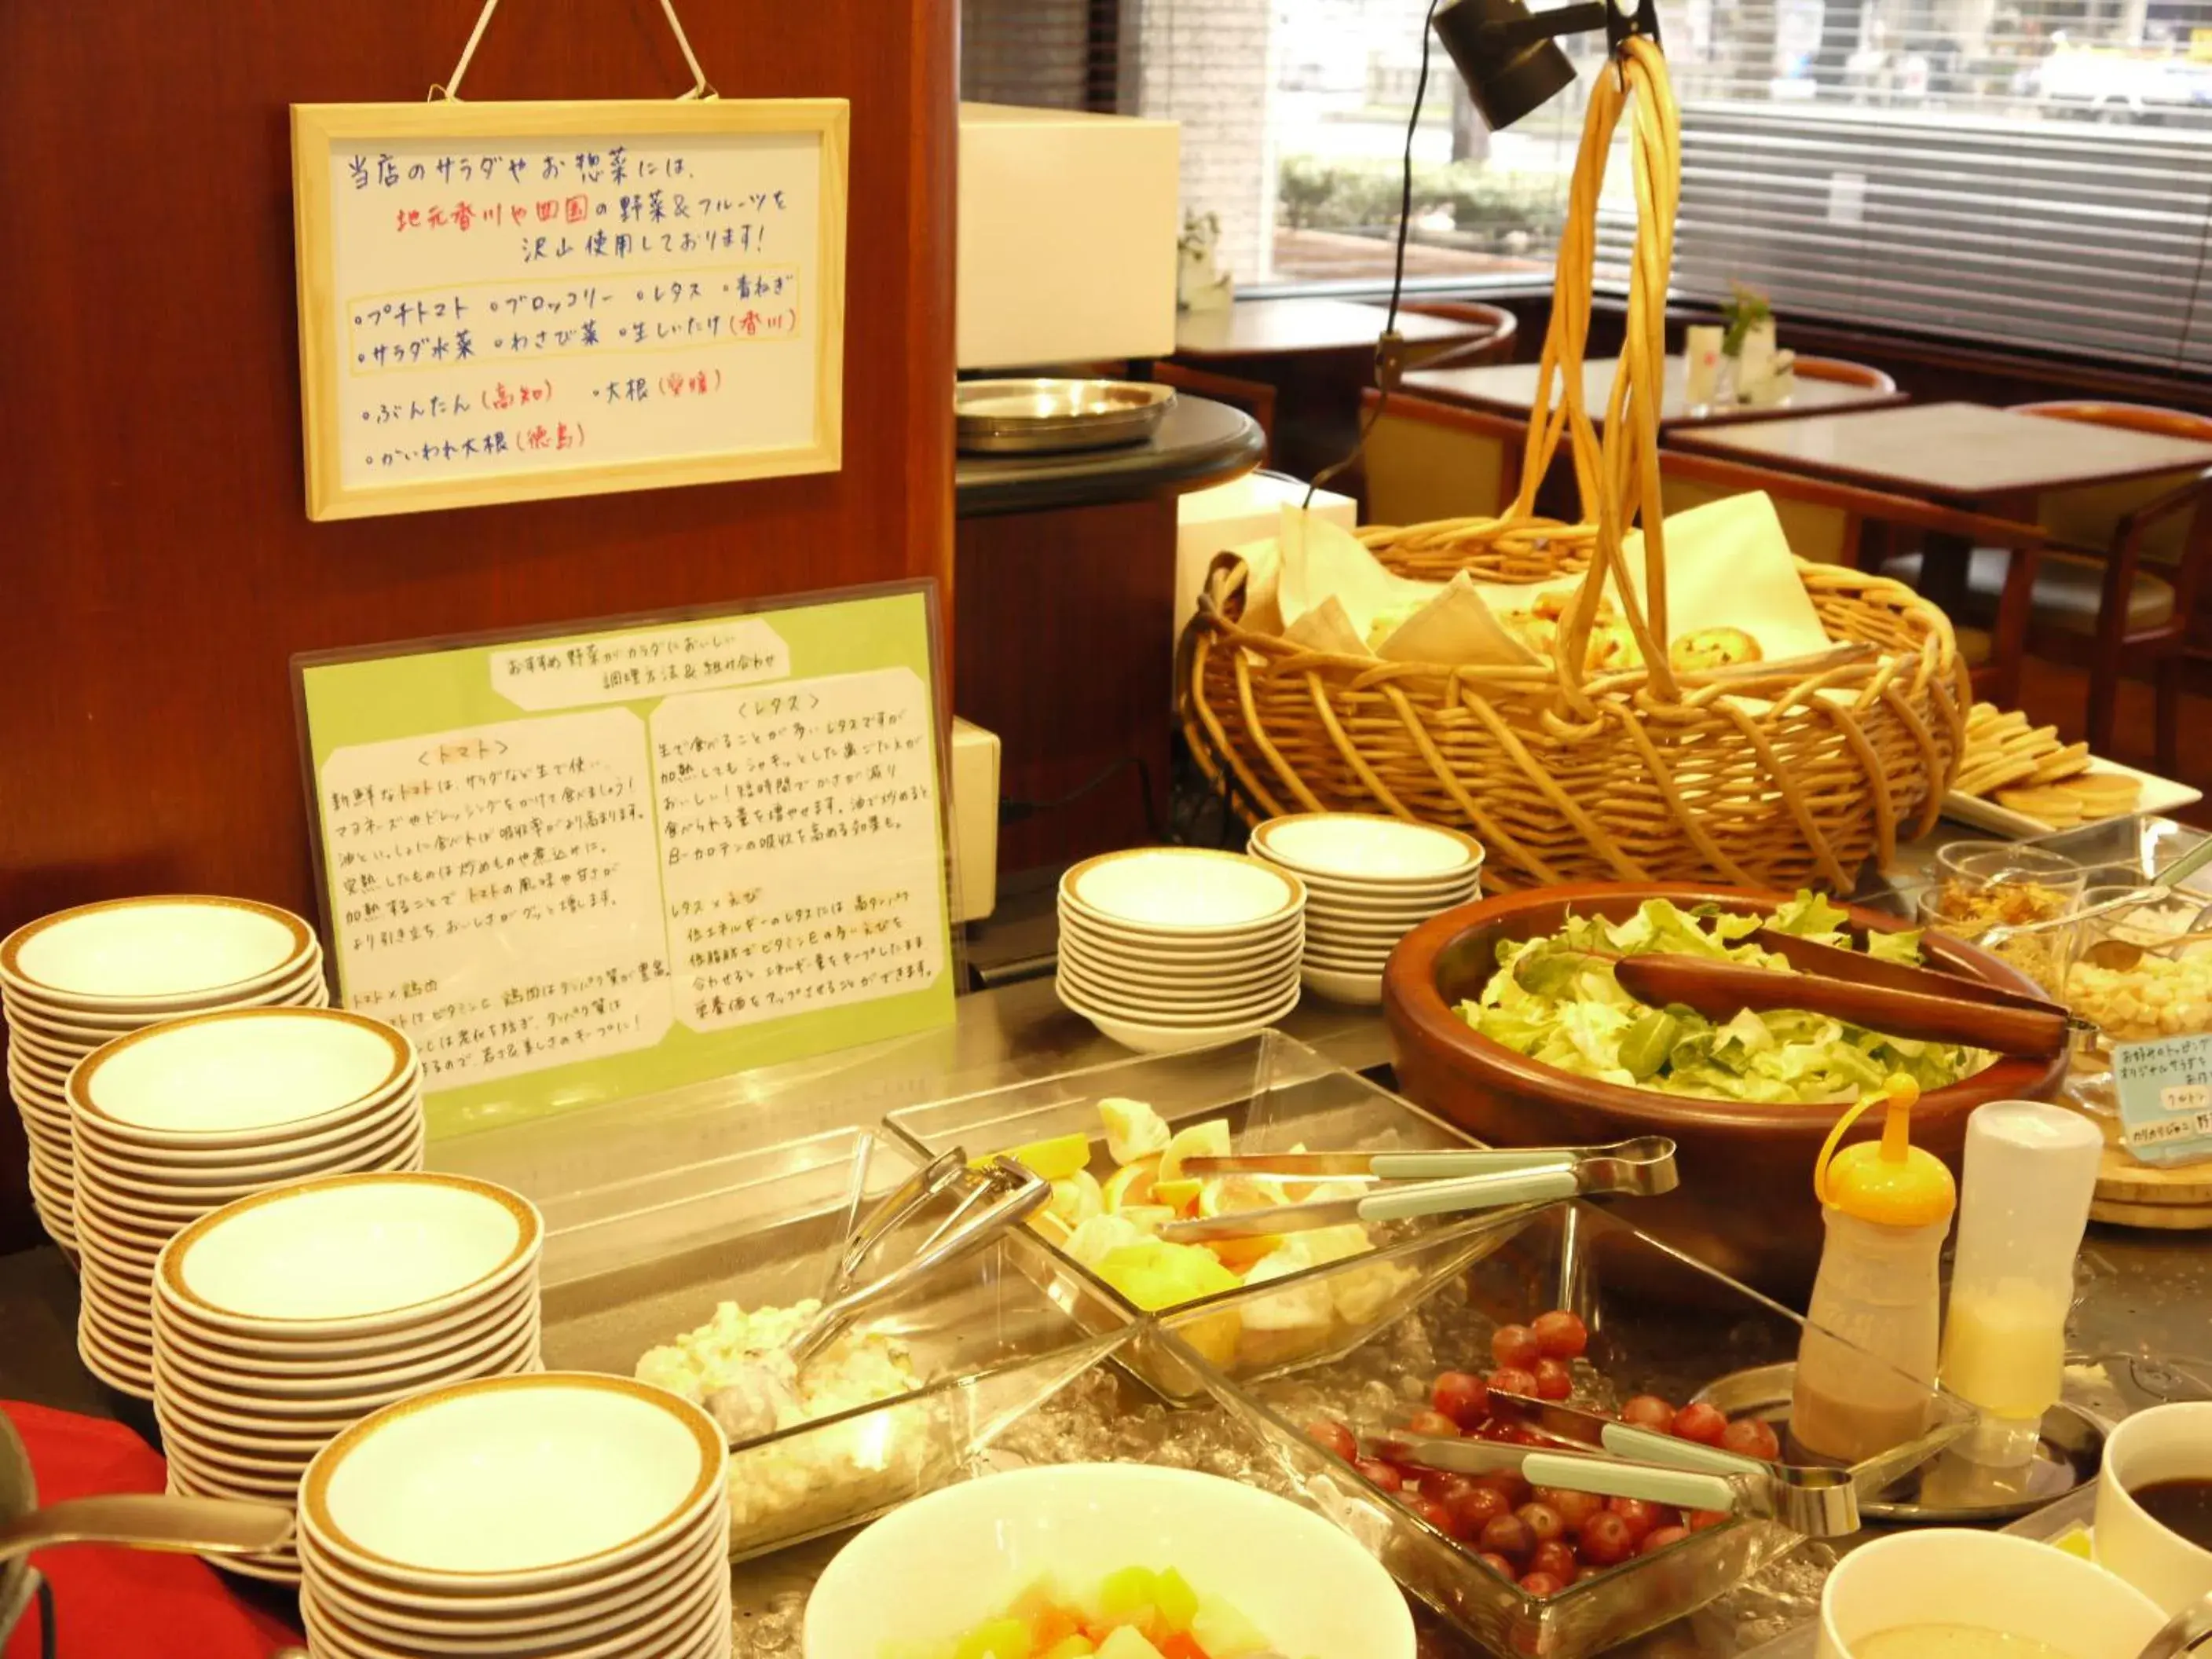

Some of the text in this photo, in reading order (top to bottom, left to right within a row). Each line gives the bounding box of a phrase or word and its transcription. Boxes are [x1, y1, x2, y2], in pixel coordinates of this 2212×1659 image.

[654, 282, 701, 302] レタス
[511, 318, 599, 351] わさび菜
